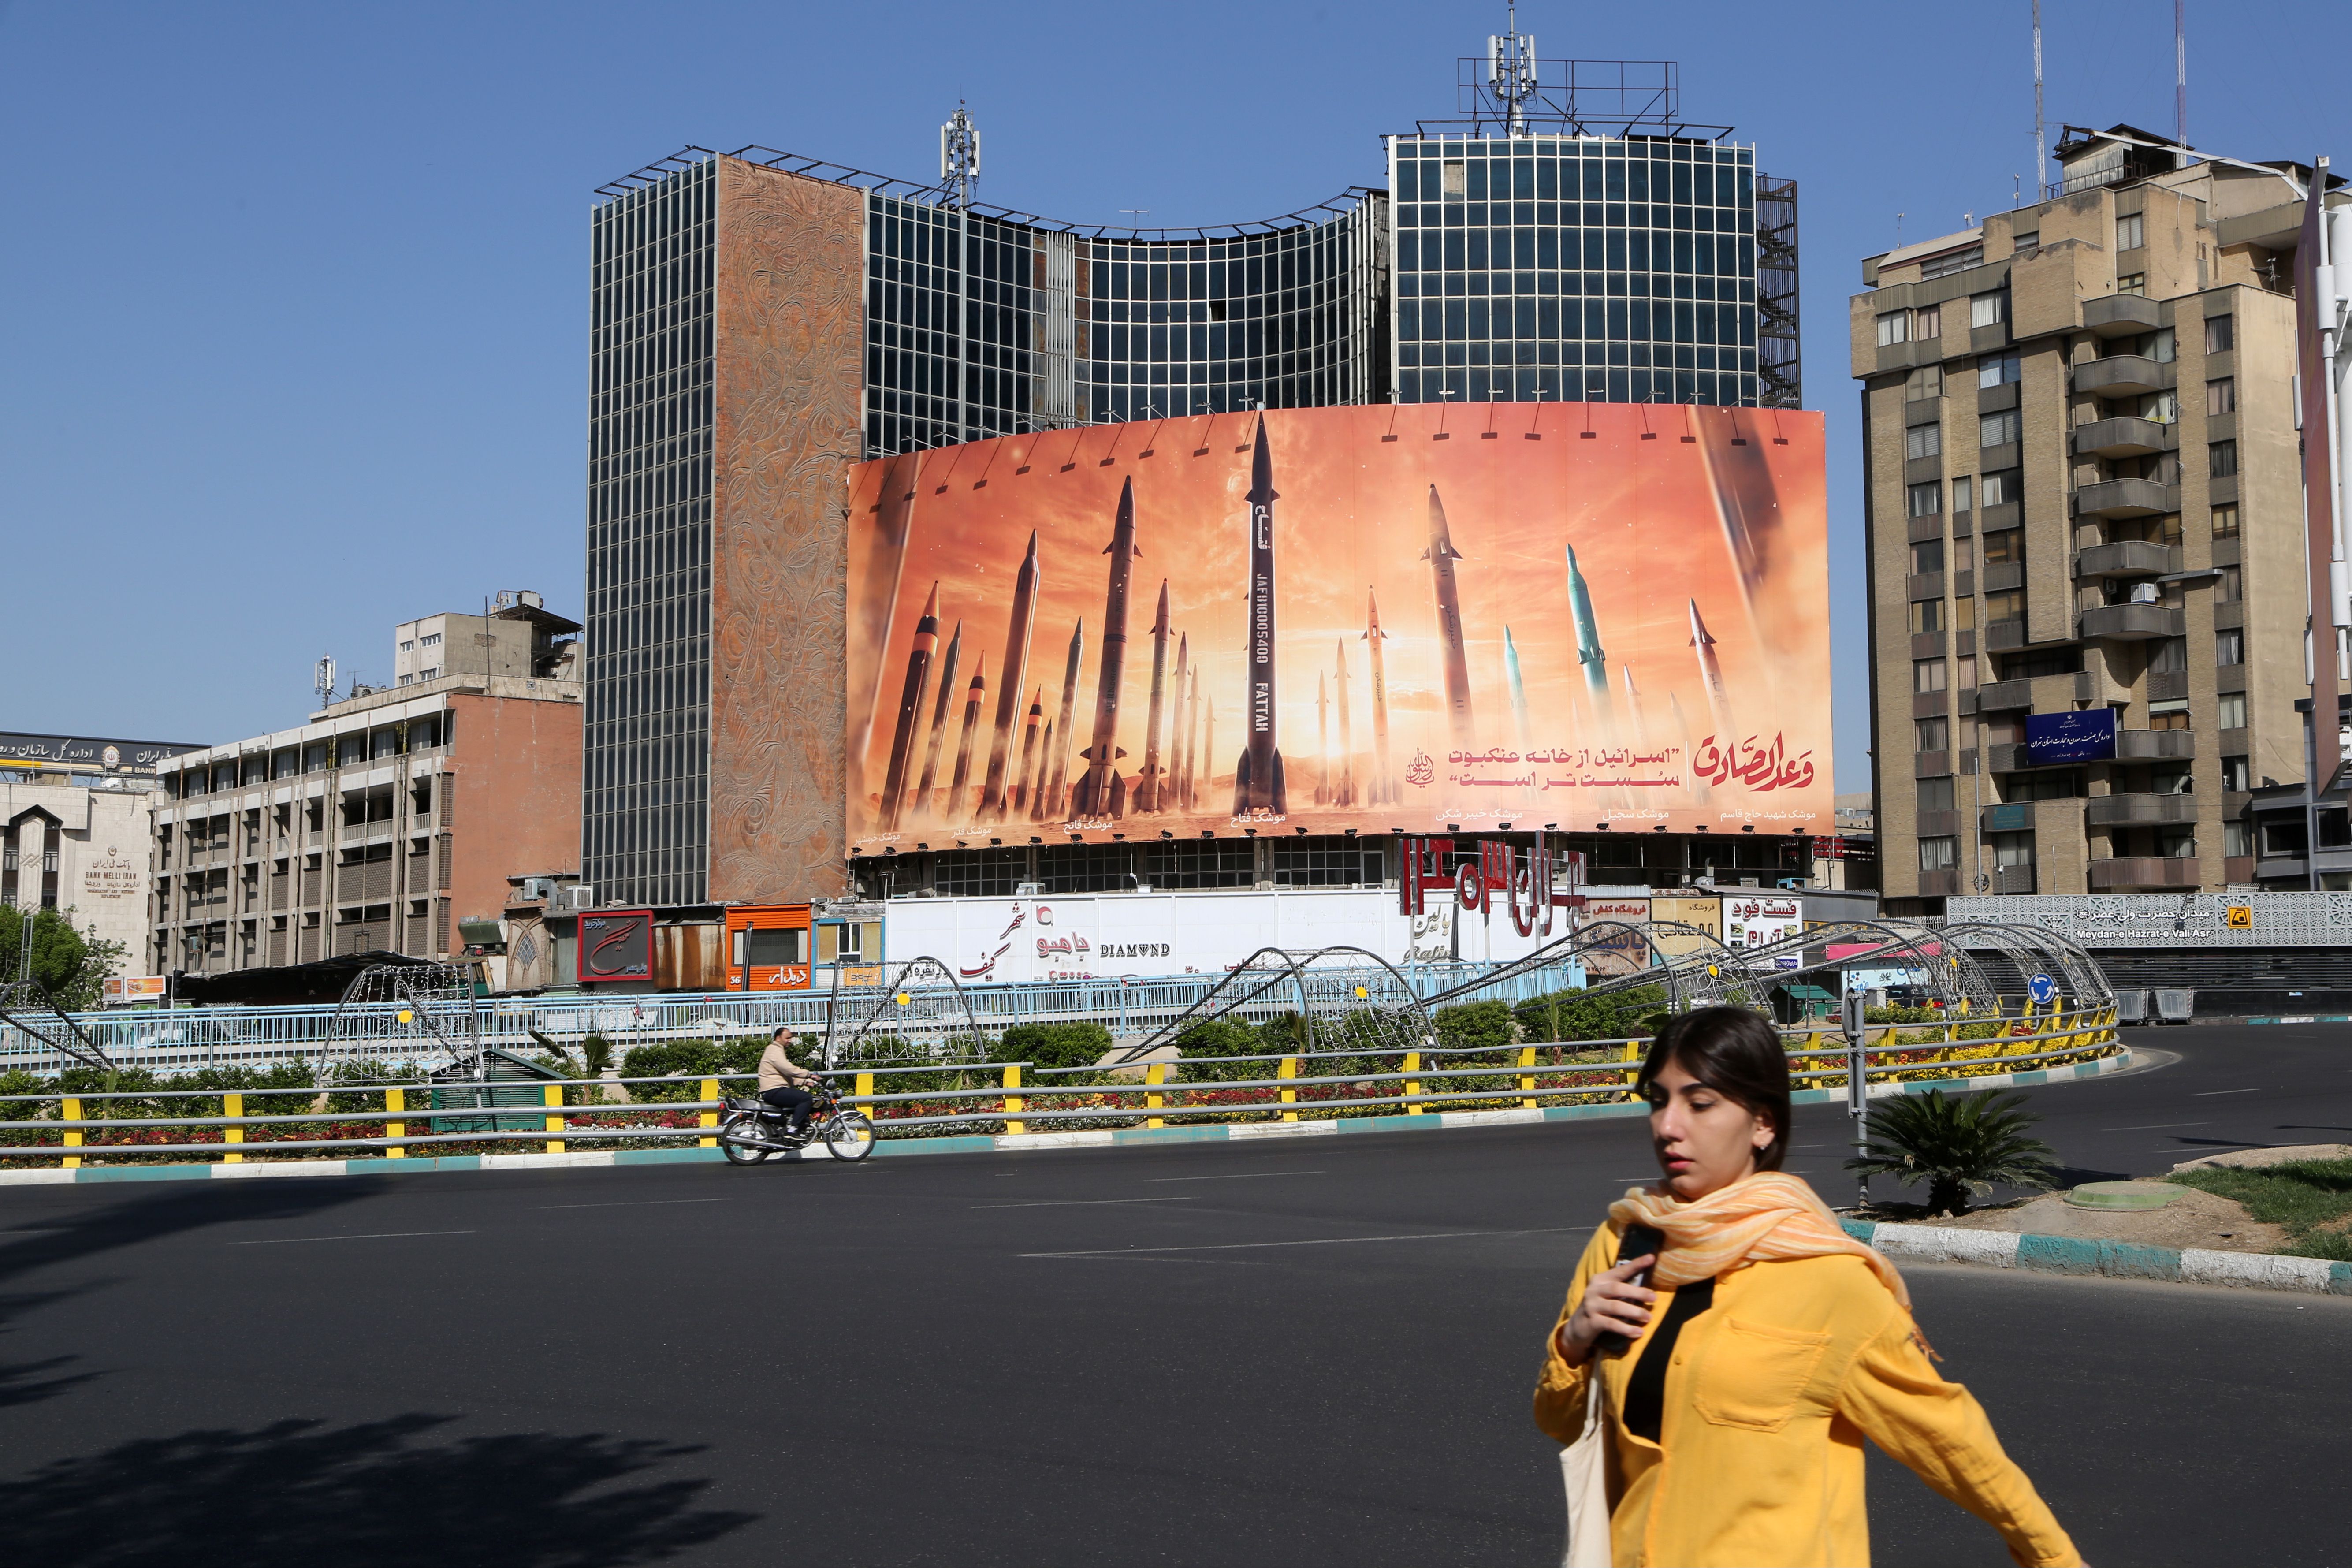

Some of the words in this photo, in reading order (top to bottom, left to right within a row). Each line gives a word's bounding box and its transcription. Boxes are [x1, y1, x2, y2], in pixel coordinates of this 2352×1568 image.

[1255, 682, 1269, 732] FATTAH
[2031, 737, 2042, 748] تهران
[2042, 736, 2053, 747] استان
[2053, 733, 2067, 747] تجارت
[2095, 729, 2104, 743] کل
[18, 744, 49, 756] سازمان
[52, 738, 72, 761] کل
[70, 749, 93, 758] اداره
[1525, 748, 1573, 764] خانه
[137, 750, 160, 767] ایران
[1448, 747, 1520, 768] عنکبوت
[1575, 748, 1589, 768] از
[1541, 772, 1577, 791] تر
[1230, 813, 1251, 827] فتاح
[1254, 812, 1286, 823] موشک
[1435, 808, 1462, 821] شکن
[1463, 808, 1487, 821] خیبر
[1489, 808, 1523, 821] موشک
[1602, 808, 1634, 821] سجیل
[1637, 808, 1669, 821] موشک
[1720, 809, 1743, 822] قاسم
[1745, 809, 1762, 822] حاج
[1764, 810, 1786, 819] شهید
[1788, 809, 1816, 821] موشک
[966, 825, 992, 837] موشک
[1064, 819, 1082, 834] فاتح
[1084, 819, 1113, 831] موشک
[878, 833, 901, 842] موشک
[951, 826, 965, 838] قدر
[854, 834, 878, 845] خرمشهر
[93, 859, 108, 868] ایران
[116, 859, 130, 870] بانک
[1593, 905, 1613, 915] کفش
[1615, 904, 1646, 915] فروشگاه
[1689, 903, 1715, 912] فروشگاه
[1732, 898, 1760, 920] فود
[1762, 898, 1797, 918] فست
[999, 902, 1026, 940] شهر
[2090, 911, 2114, 921] عصر
[2117, 909, 2136, 922] ولی
[2138, 909, 2176, 920] حضرت
[2178, 909, 2210, 920] میدان
[584, 919, 596, 929] خرید
[594, 918, 606, 928] مرکز
[2077, 930, 2125, 940] Meydan-e
[2127, 929, 2169, 938] Hazrat-e
[2172, 929, 2190, 938] Vali
[2192, 929, 2211, 938] Asr
[1036, 931, 1090, 962] بامبو
[960, 942, 1011, 981] کیف
[730, 976, 741, 984] 36
[768, 966, 806, 986] دیدار
